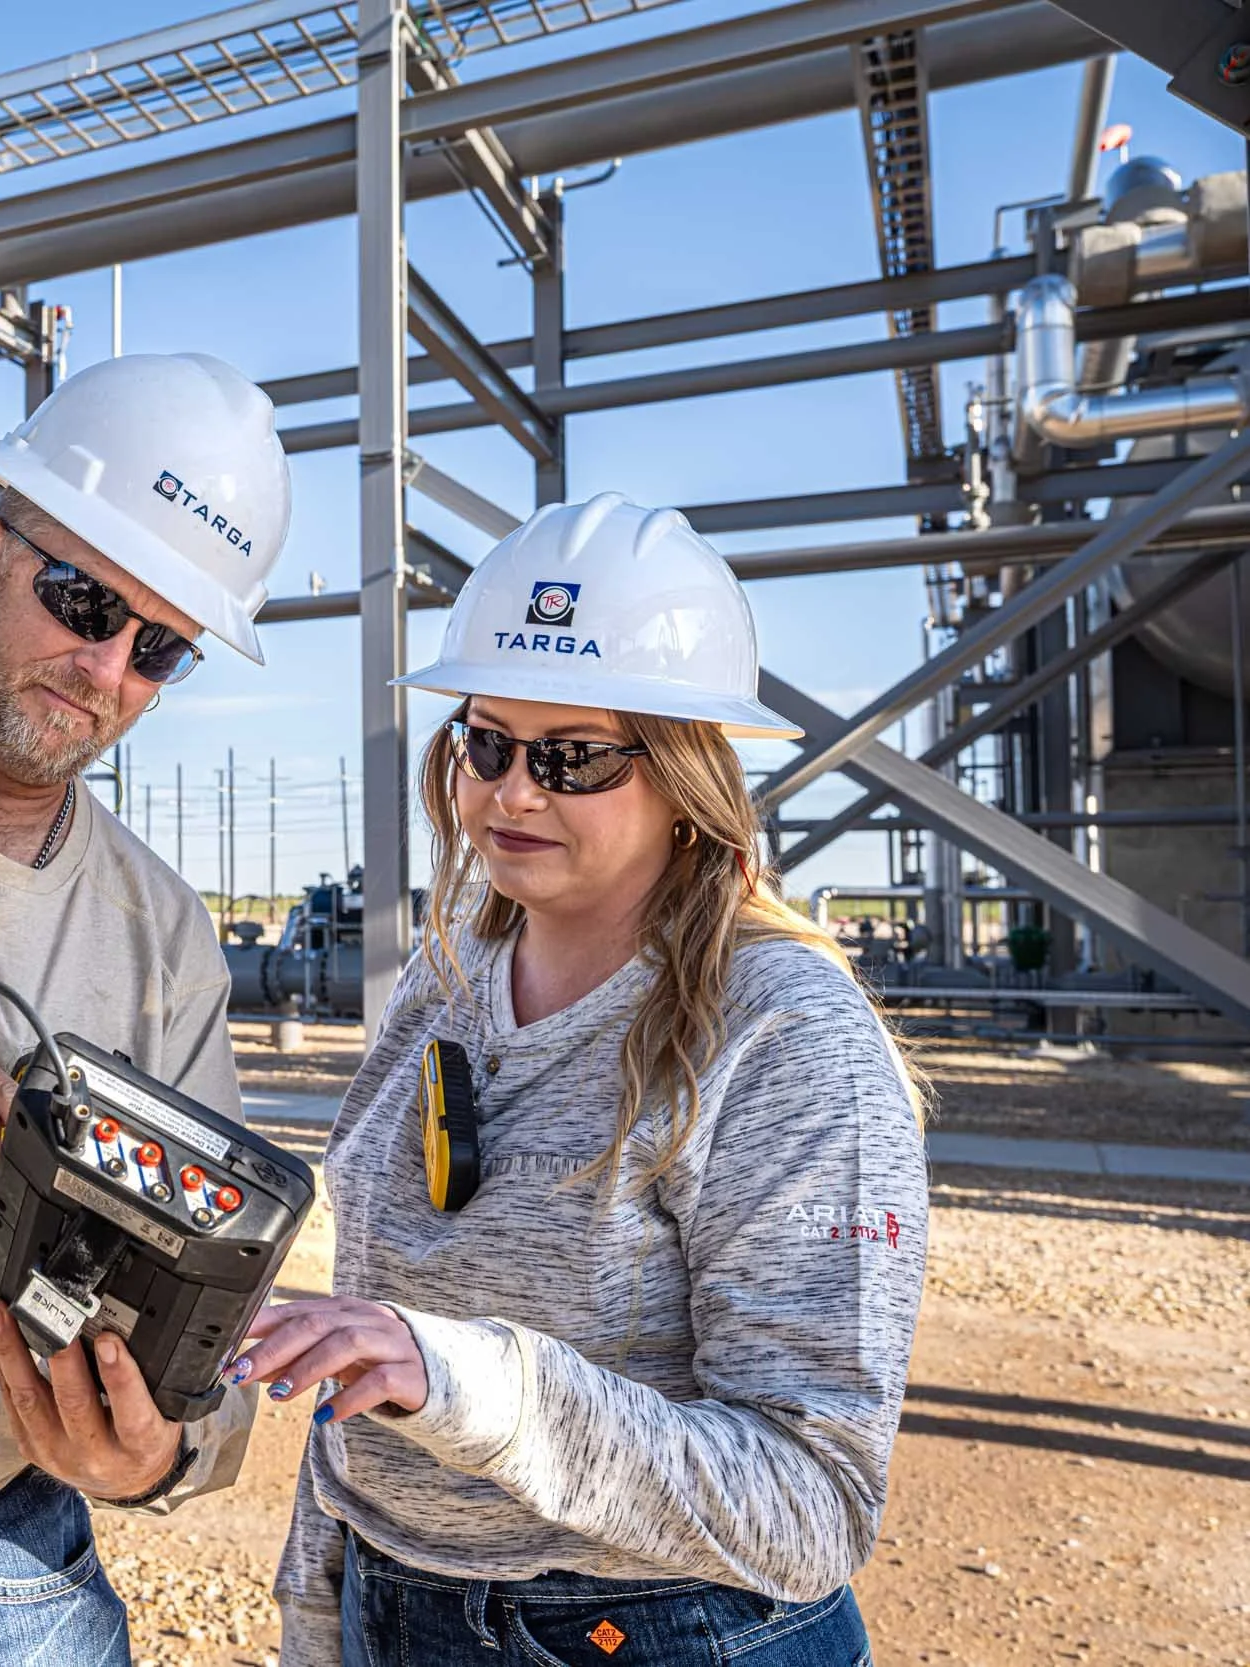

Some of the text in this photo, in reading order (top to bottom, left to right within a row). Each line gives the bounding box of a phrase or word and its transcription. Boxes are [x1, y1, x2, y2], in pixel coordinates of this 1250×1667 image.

[182, 489, 252, 557] TARGA
[495, 632, 602, 658] TARGA
[786, 1203, 886, 1227] ARIAT
[850, 1225, 879, 1241] 2112
[598, 1638, 617, 1646] 2112
